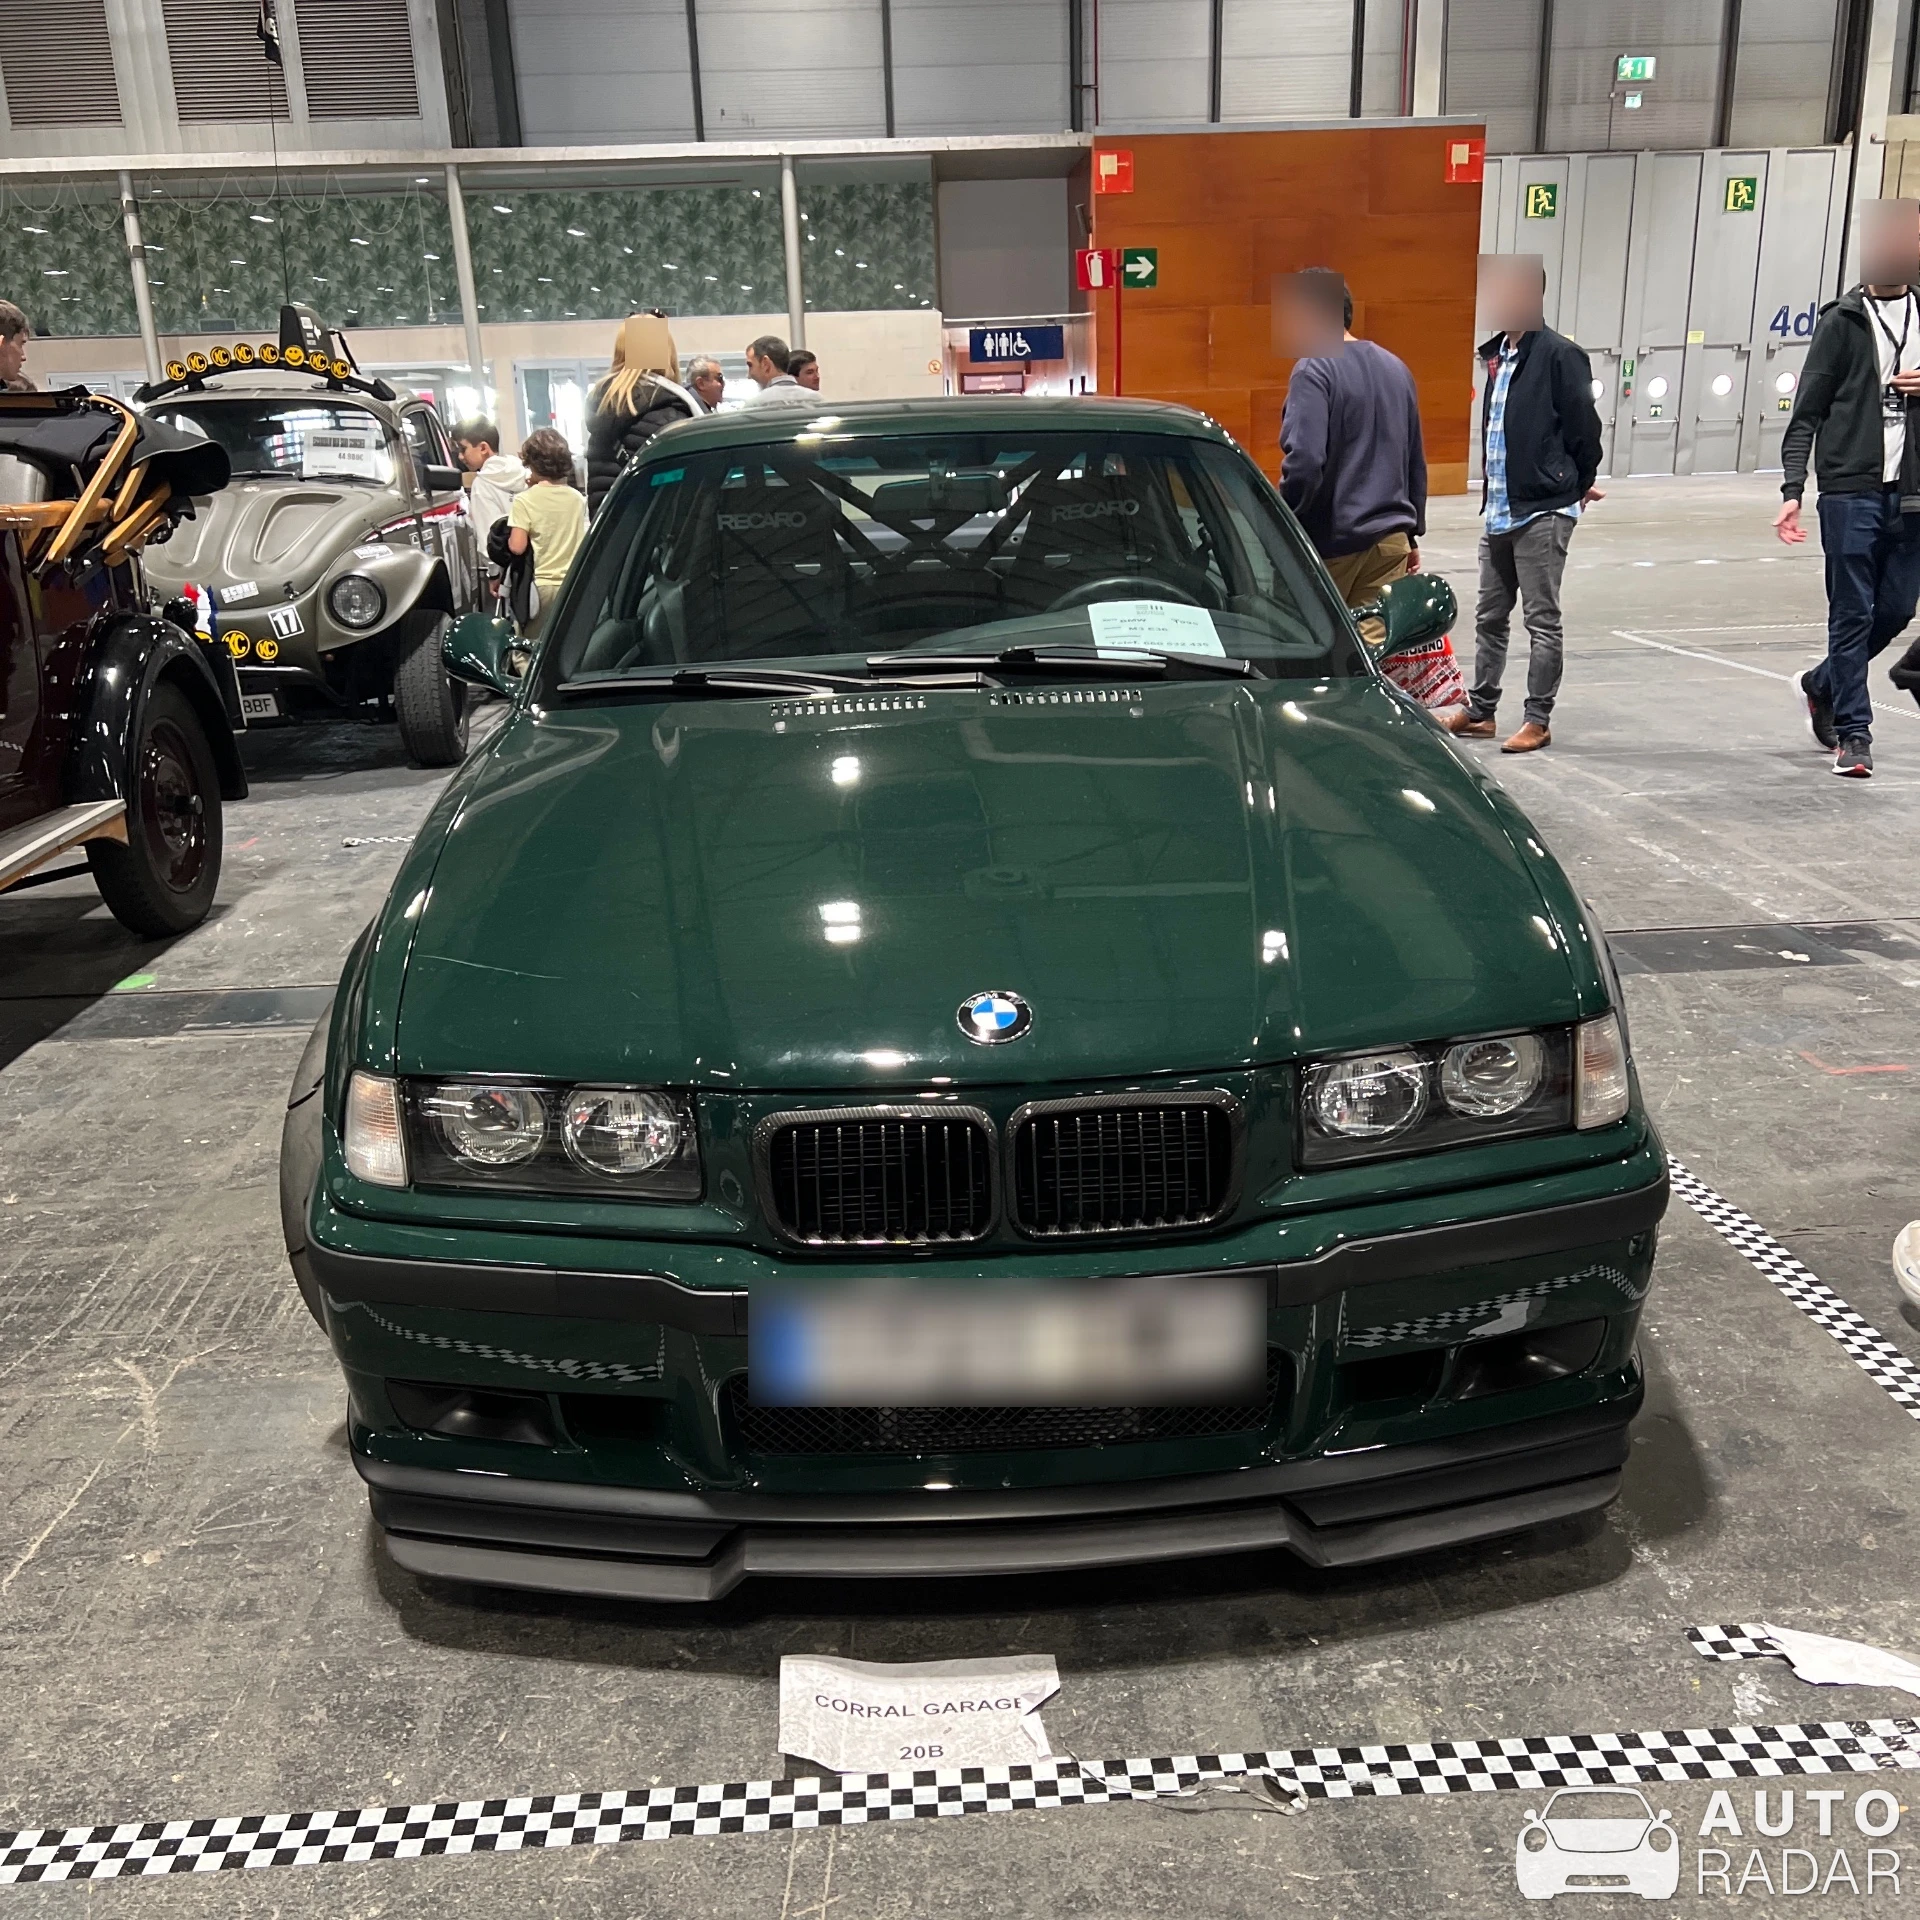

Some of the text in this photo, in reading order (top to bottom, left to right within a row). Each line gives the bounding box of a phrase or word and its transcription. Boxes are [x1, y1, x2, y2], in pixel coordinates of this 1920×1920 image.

[1769, 302, 1816, 337] 4d
[213, 349, 228, 364] KC
[236, 346, 251, 361] KC
[260, 346, 277, 361] KC
[311, 354, 327, 369] KC
[168, 364, 184, 379] KC
[189, 356, 205, 371] KC
[332, 361, 348, 377] KC
[1051, 499, 1140, 522] RECARO
[717, 511, 807, 531] RECARO
[272, 608, 298, 636] 17
[259, 641, 275, 657] KC
[243, 698, 272, 714] BBF
[815, 1694, 916, 1718] CORRAL
[899, 1744, 944, 1760] 20B
